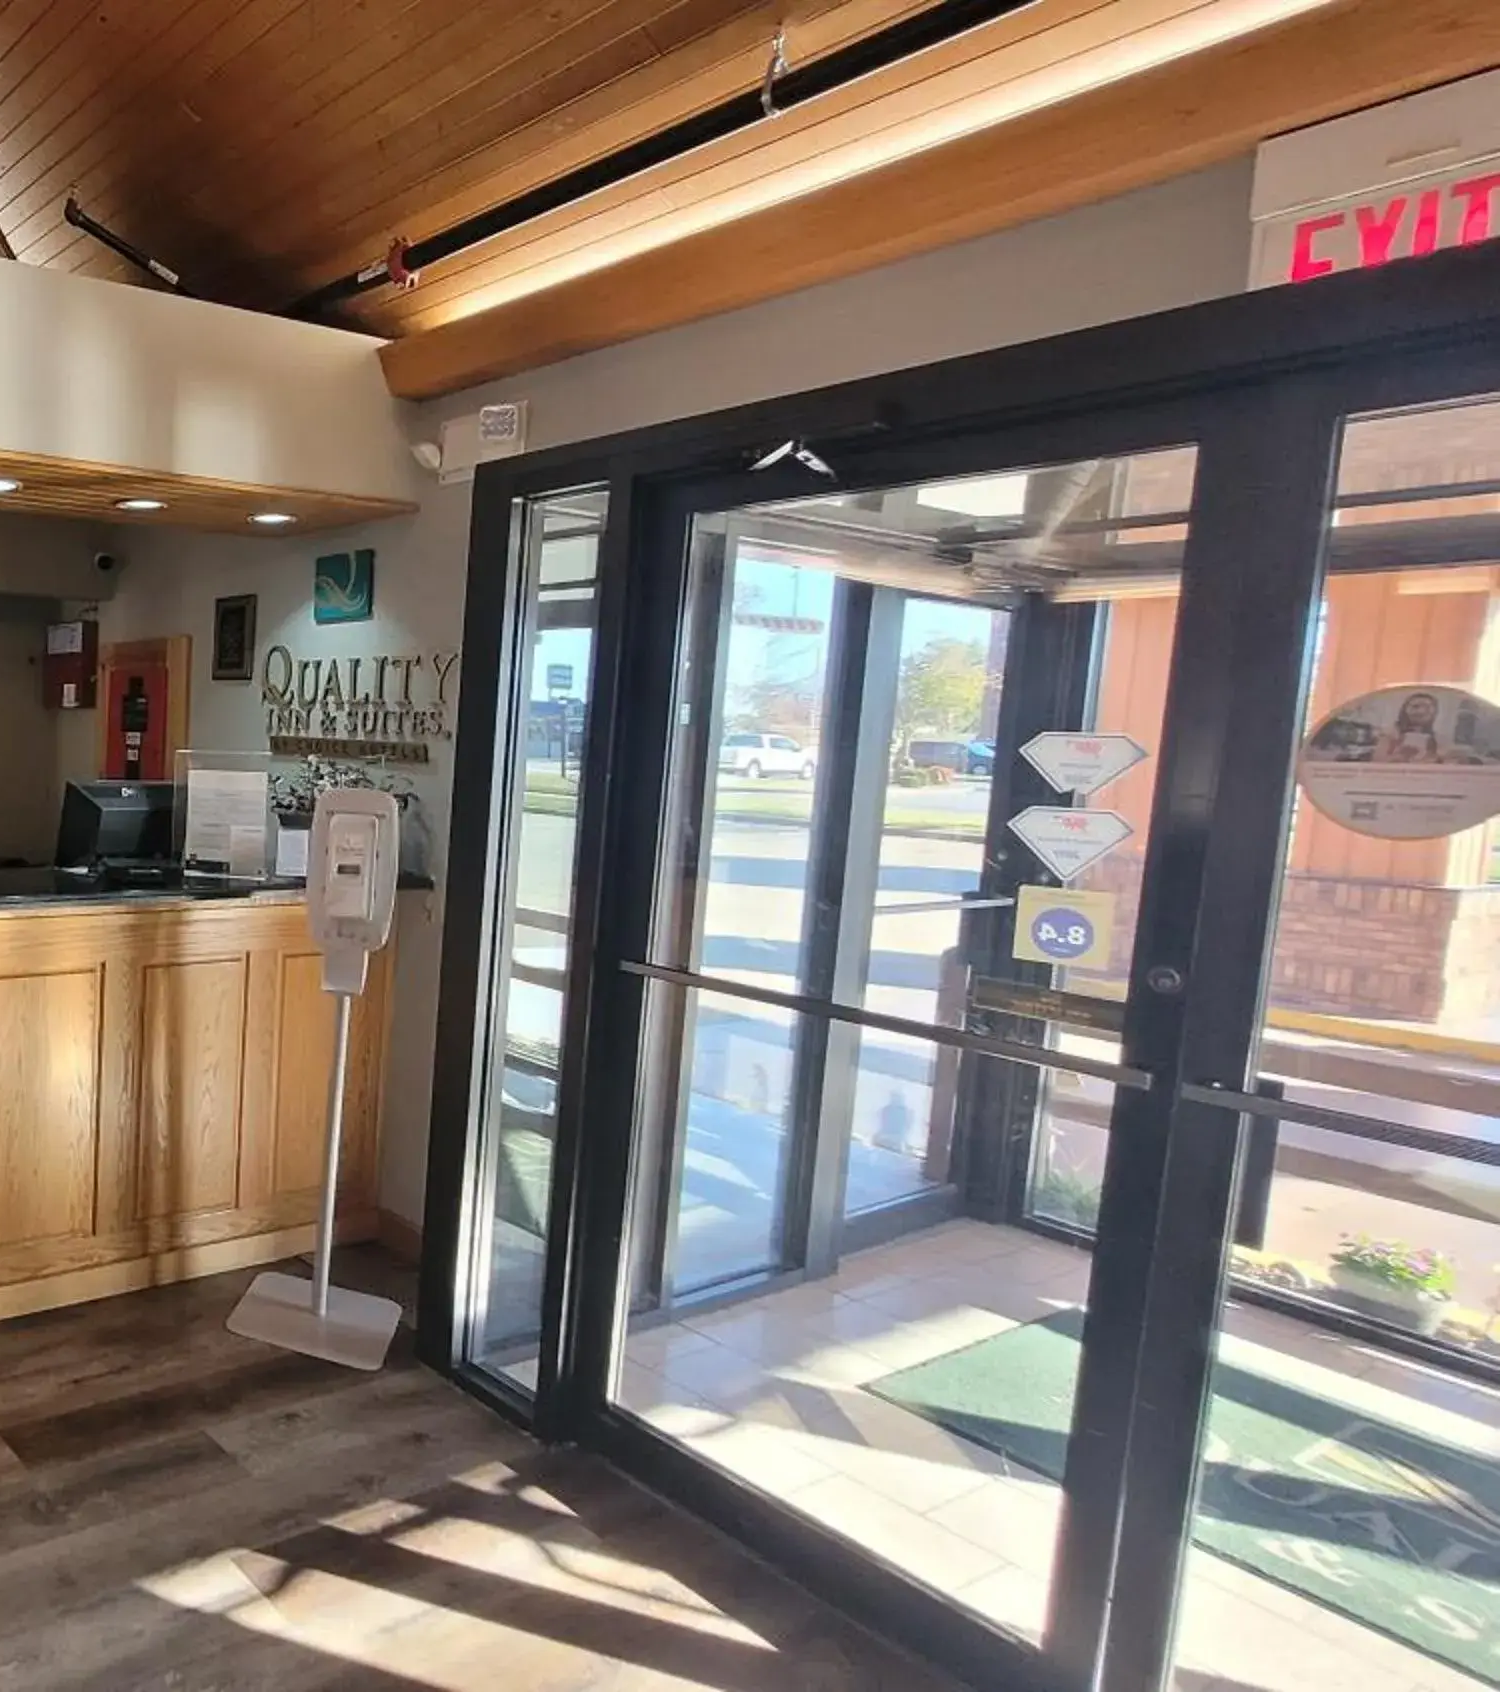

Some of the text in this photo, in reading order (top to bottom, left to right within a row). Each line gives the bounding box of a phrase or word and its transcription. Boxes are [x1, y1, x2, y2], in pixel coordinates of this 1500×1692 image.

[262, 645, 459, 709] QUALITY
[268, 706, 313, 735] INN
[320, 708, 337, 736] &
